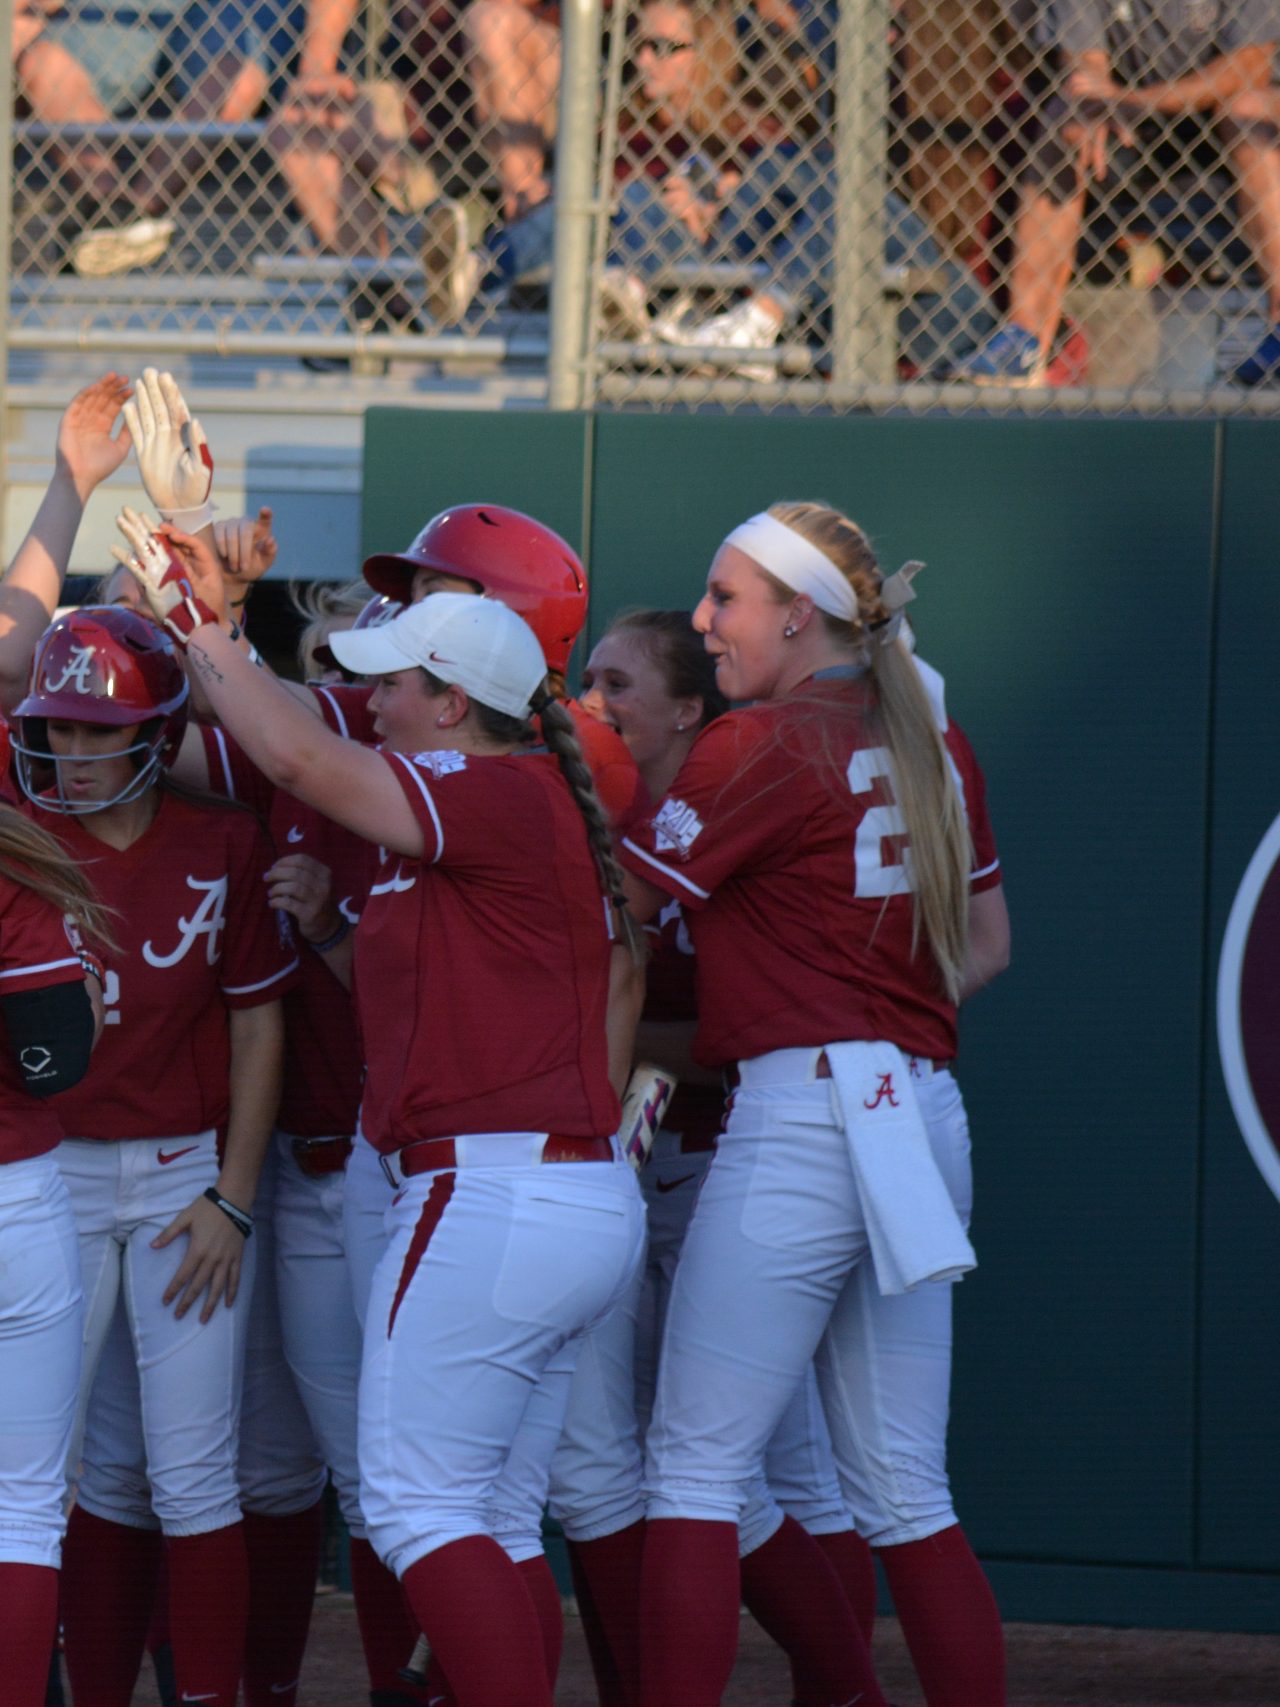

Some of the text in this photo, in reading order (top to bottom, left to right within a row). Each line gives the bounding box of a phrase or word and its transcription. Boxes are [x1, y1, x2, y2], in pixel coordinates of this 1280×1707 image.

[45, 645, 96, 694] A
[142, 873, 228, 969] A
[863, 1072, 900, 1109] A
